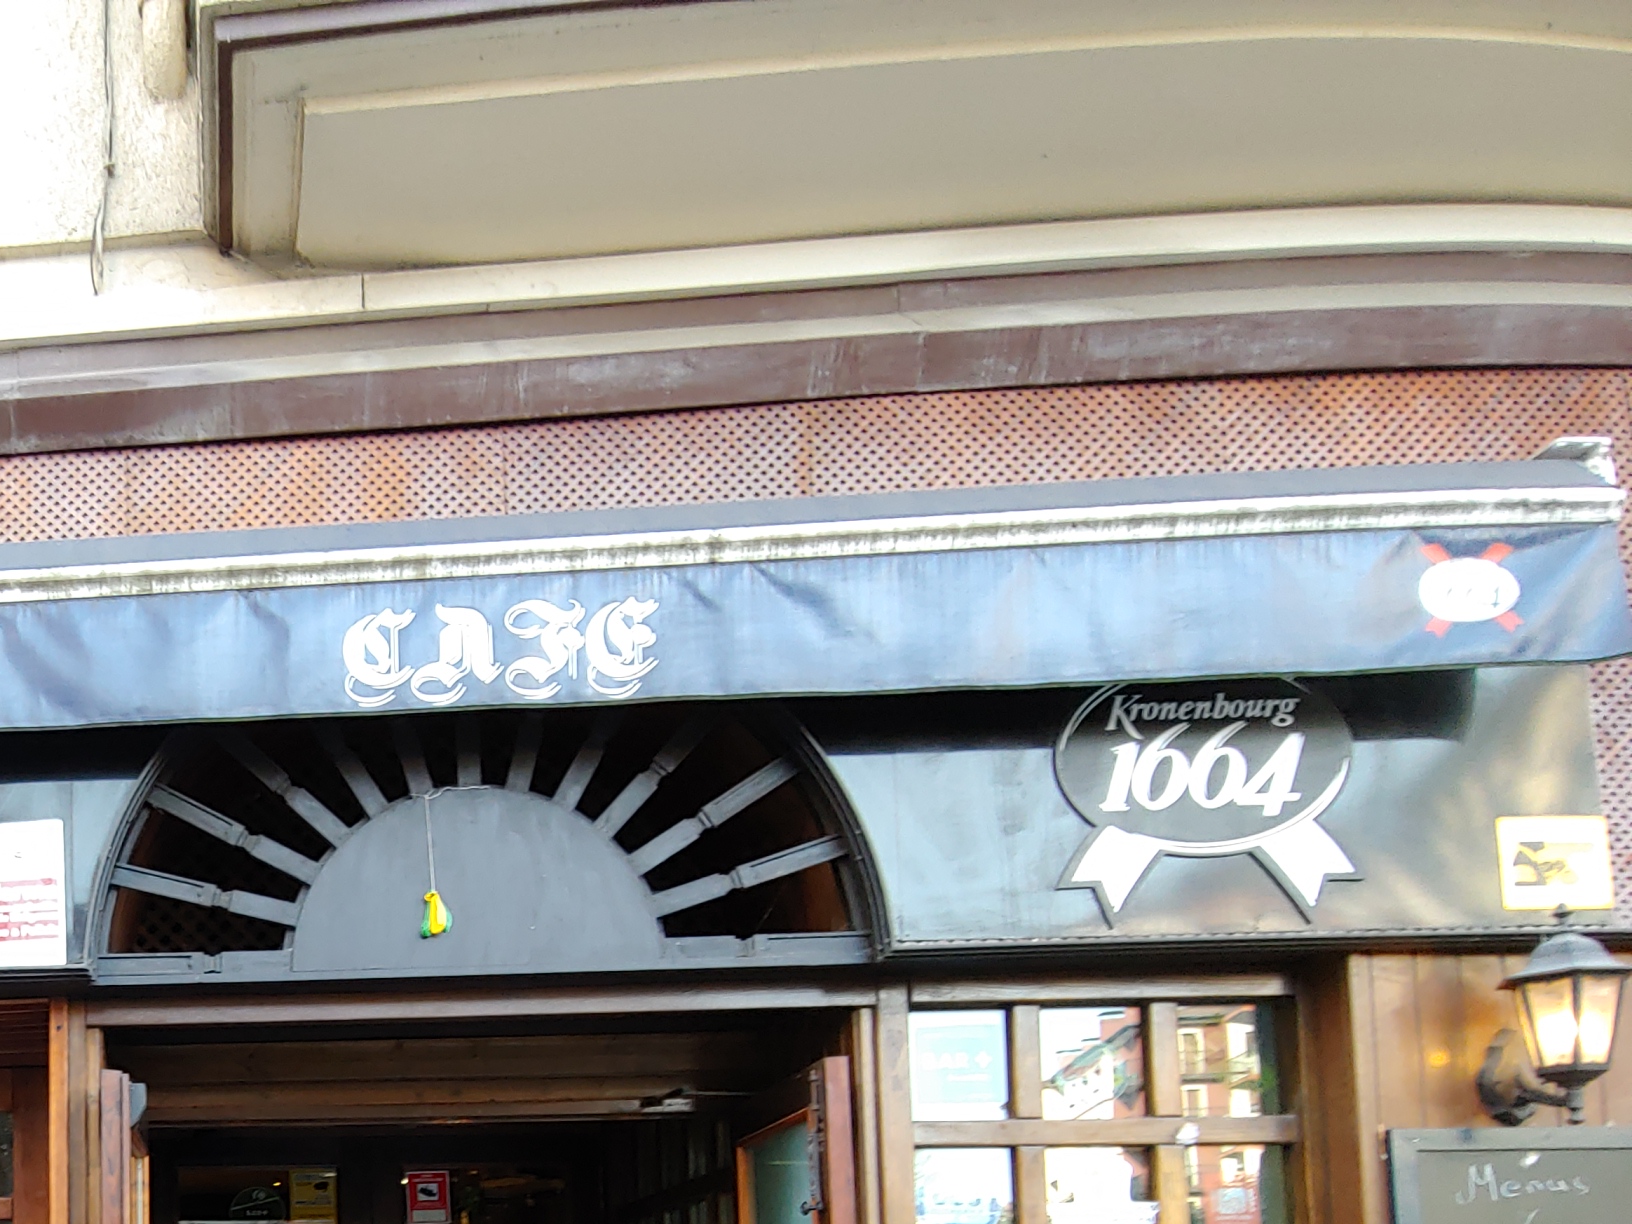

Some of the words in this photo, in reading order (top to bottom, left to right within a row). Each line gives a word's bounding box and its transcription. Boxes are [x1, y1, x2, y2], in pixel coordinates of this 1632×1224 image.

[342, 596, 659, 708] CAFE
[1105, 692, 1301, 741] Kronenbourg
[1098, 720, 1306, 817] 1664
